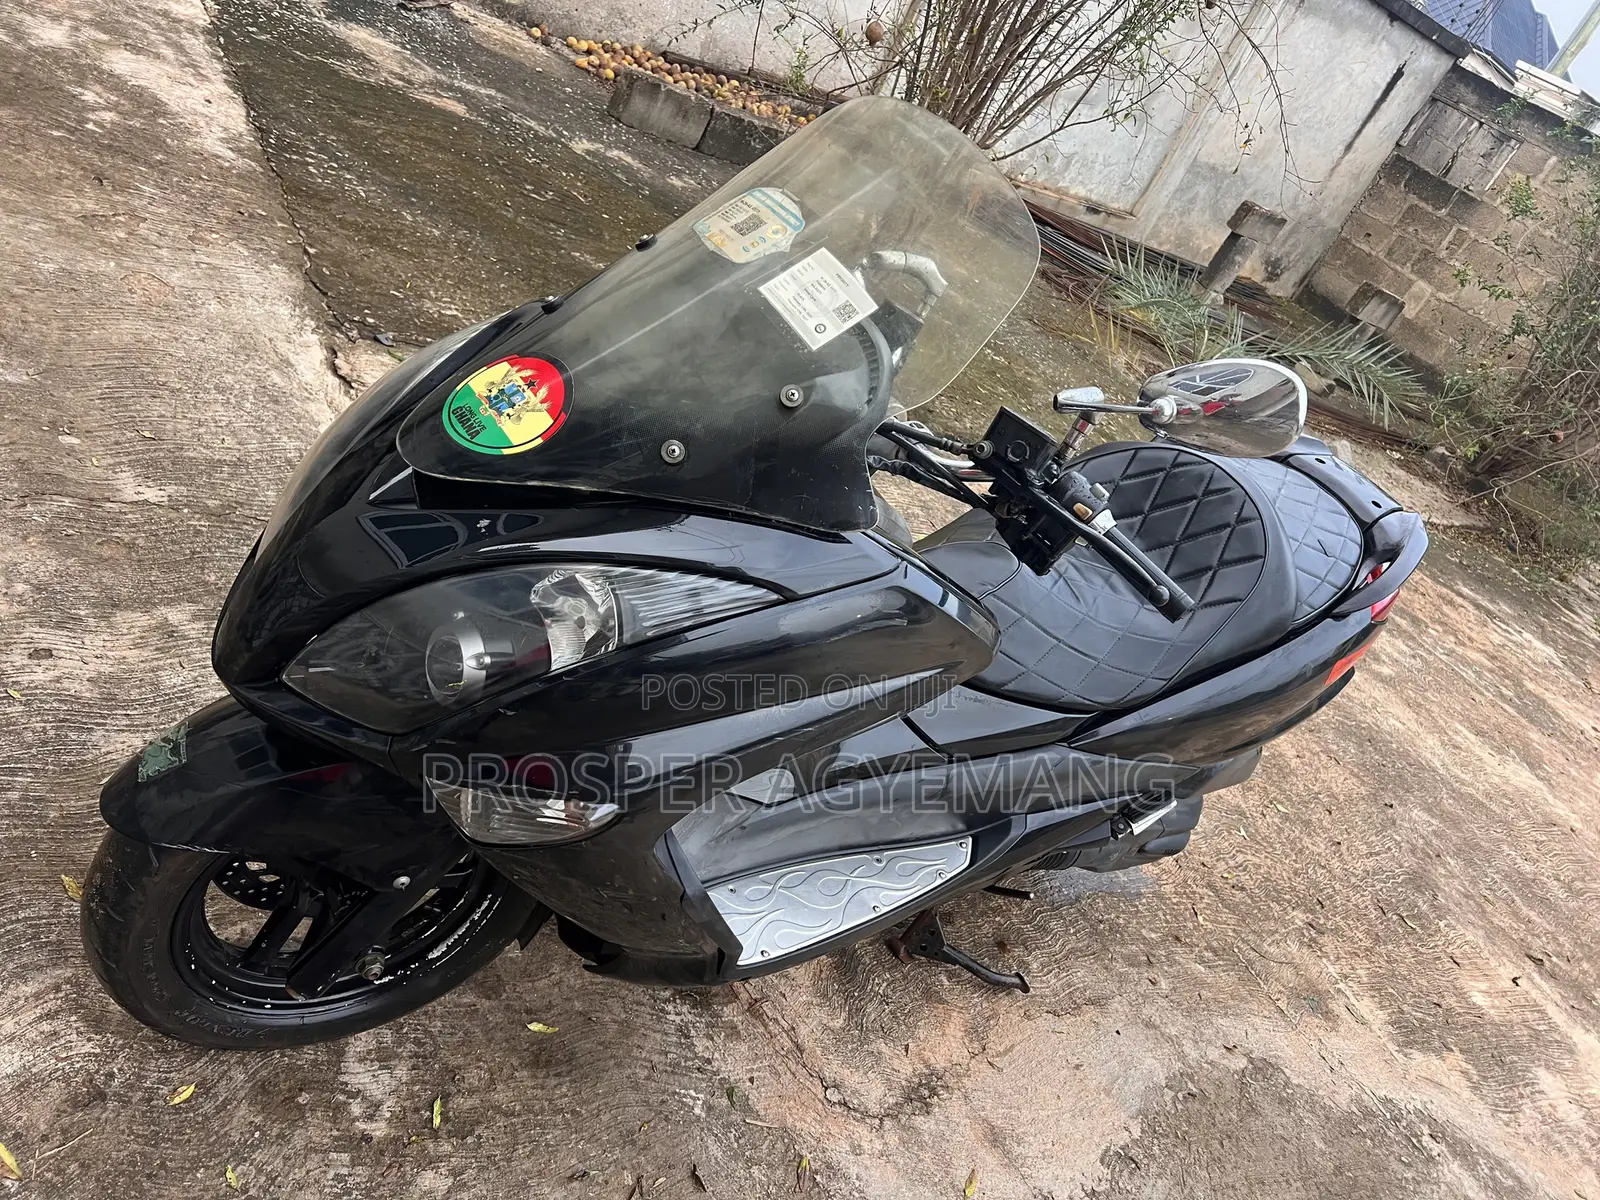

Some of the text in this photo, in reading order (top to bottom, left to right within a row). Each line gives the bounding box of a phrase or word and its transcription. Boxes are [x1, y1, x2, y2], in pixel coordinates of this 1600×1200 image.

[452, 406, 481, 440] GHANA
[463, 402, 487, 432] LONG LIVE
